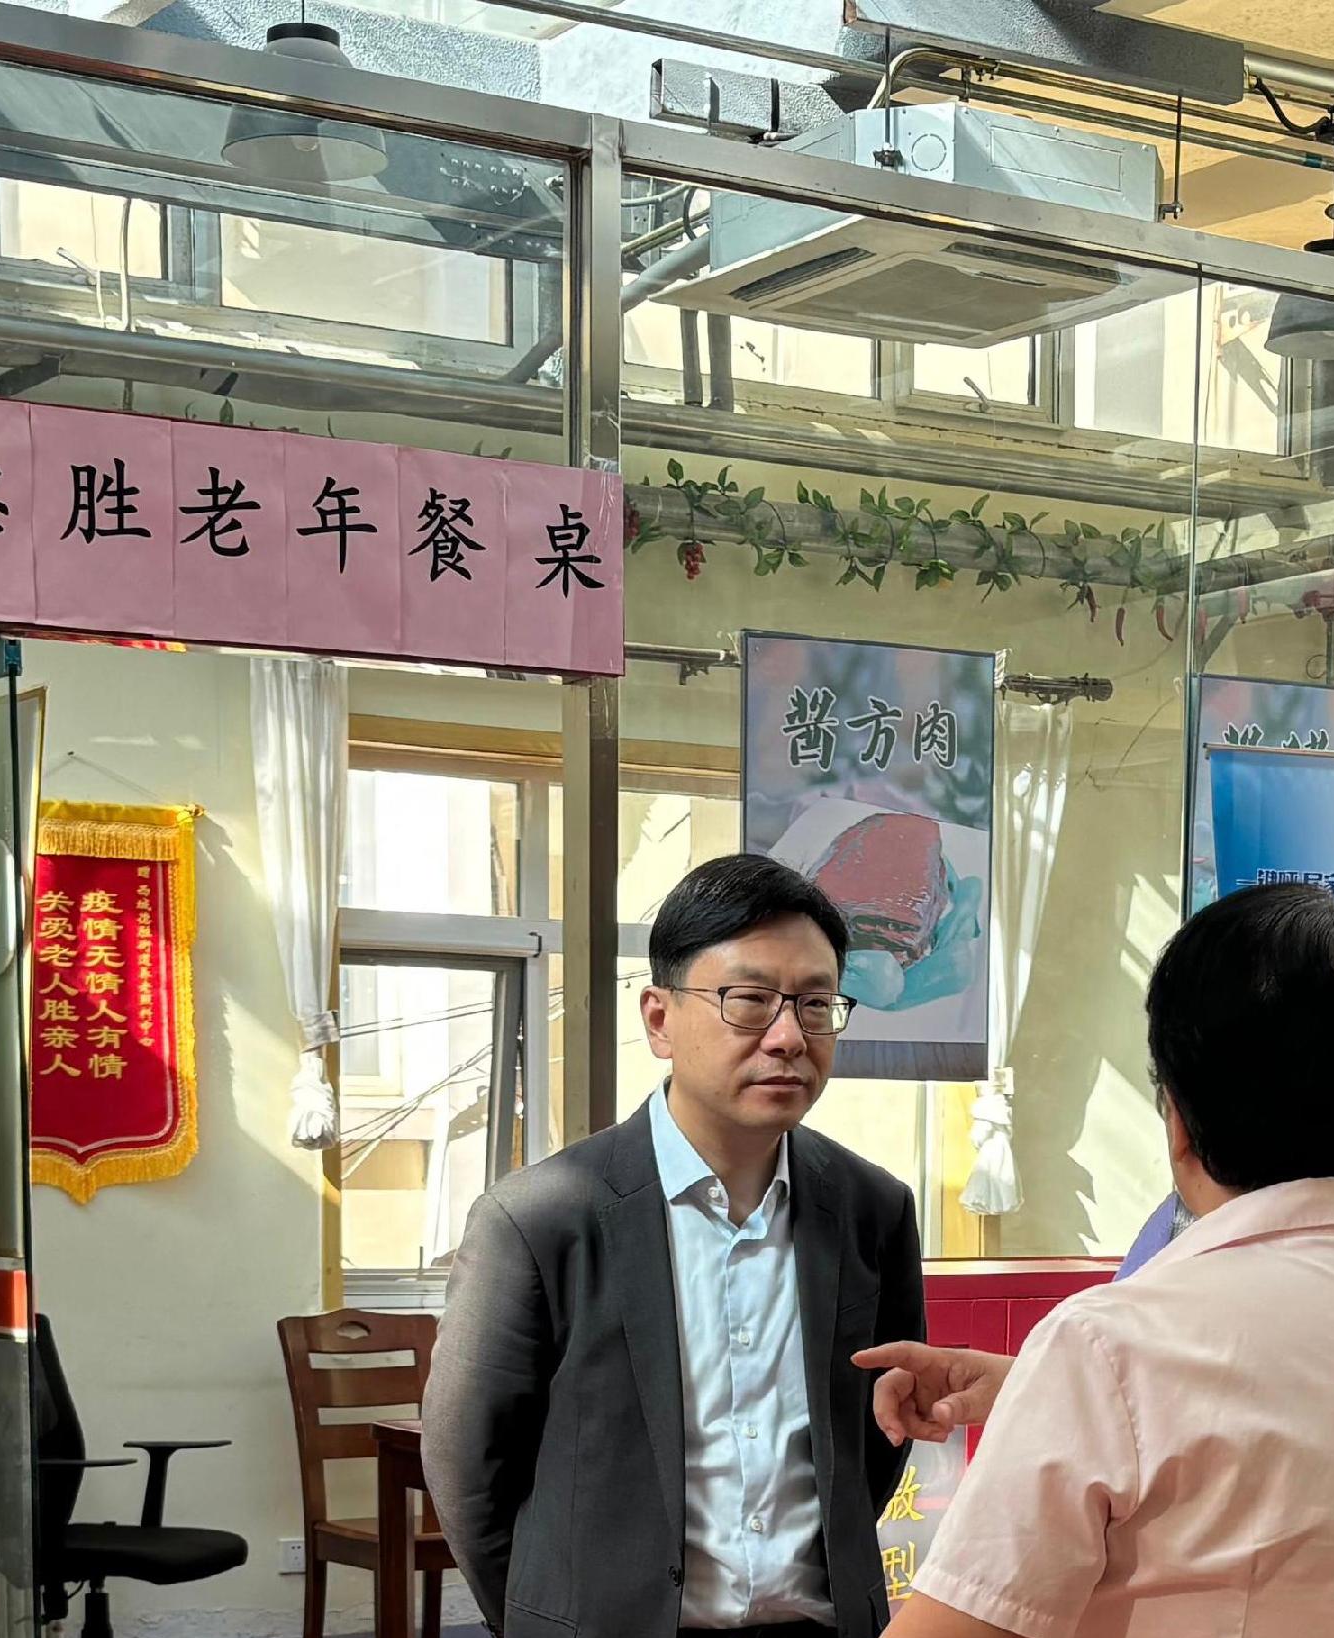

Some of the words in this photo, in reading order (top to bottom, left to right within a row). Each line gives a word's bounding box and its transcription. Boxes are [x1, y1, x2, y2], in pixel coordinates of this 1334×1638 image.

[781, 685, 959, 772] 酱方肉
[37, 889, 82, 1078] 关爱老人胜亲人
[80, 888, 129, 1080] 疫情无情人有情
